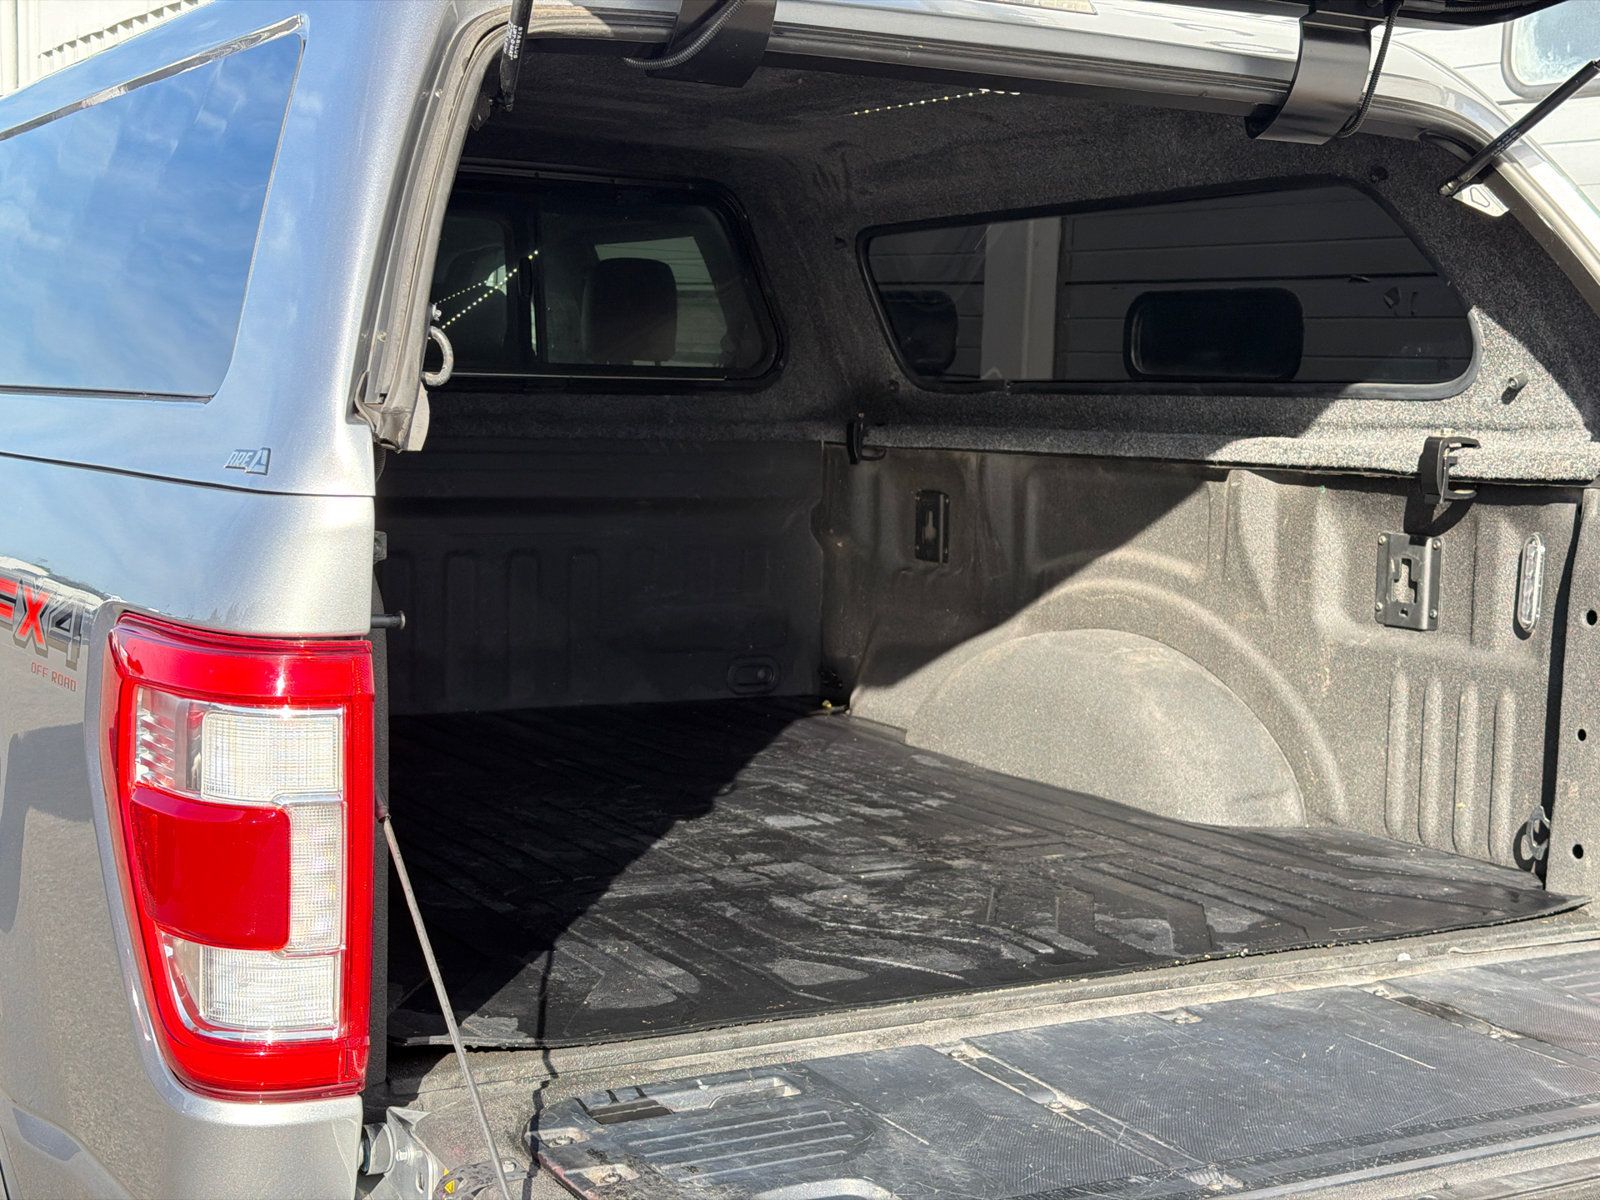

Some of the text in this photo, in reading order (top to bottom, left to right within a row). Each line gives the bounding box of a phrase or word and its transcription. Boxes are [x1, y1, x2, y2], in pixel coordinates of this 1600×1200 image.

[513, 26, 523, 59] STABILUS
[31, 661, 77, 692] OFF ROAD
